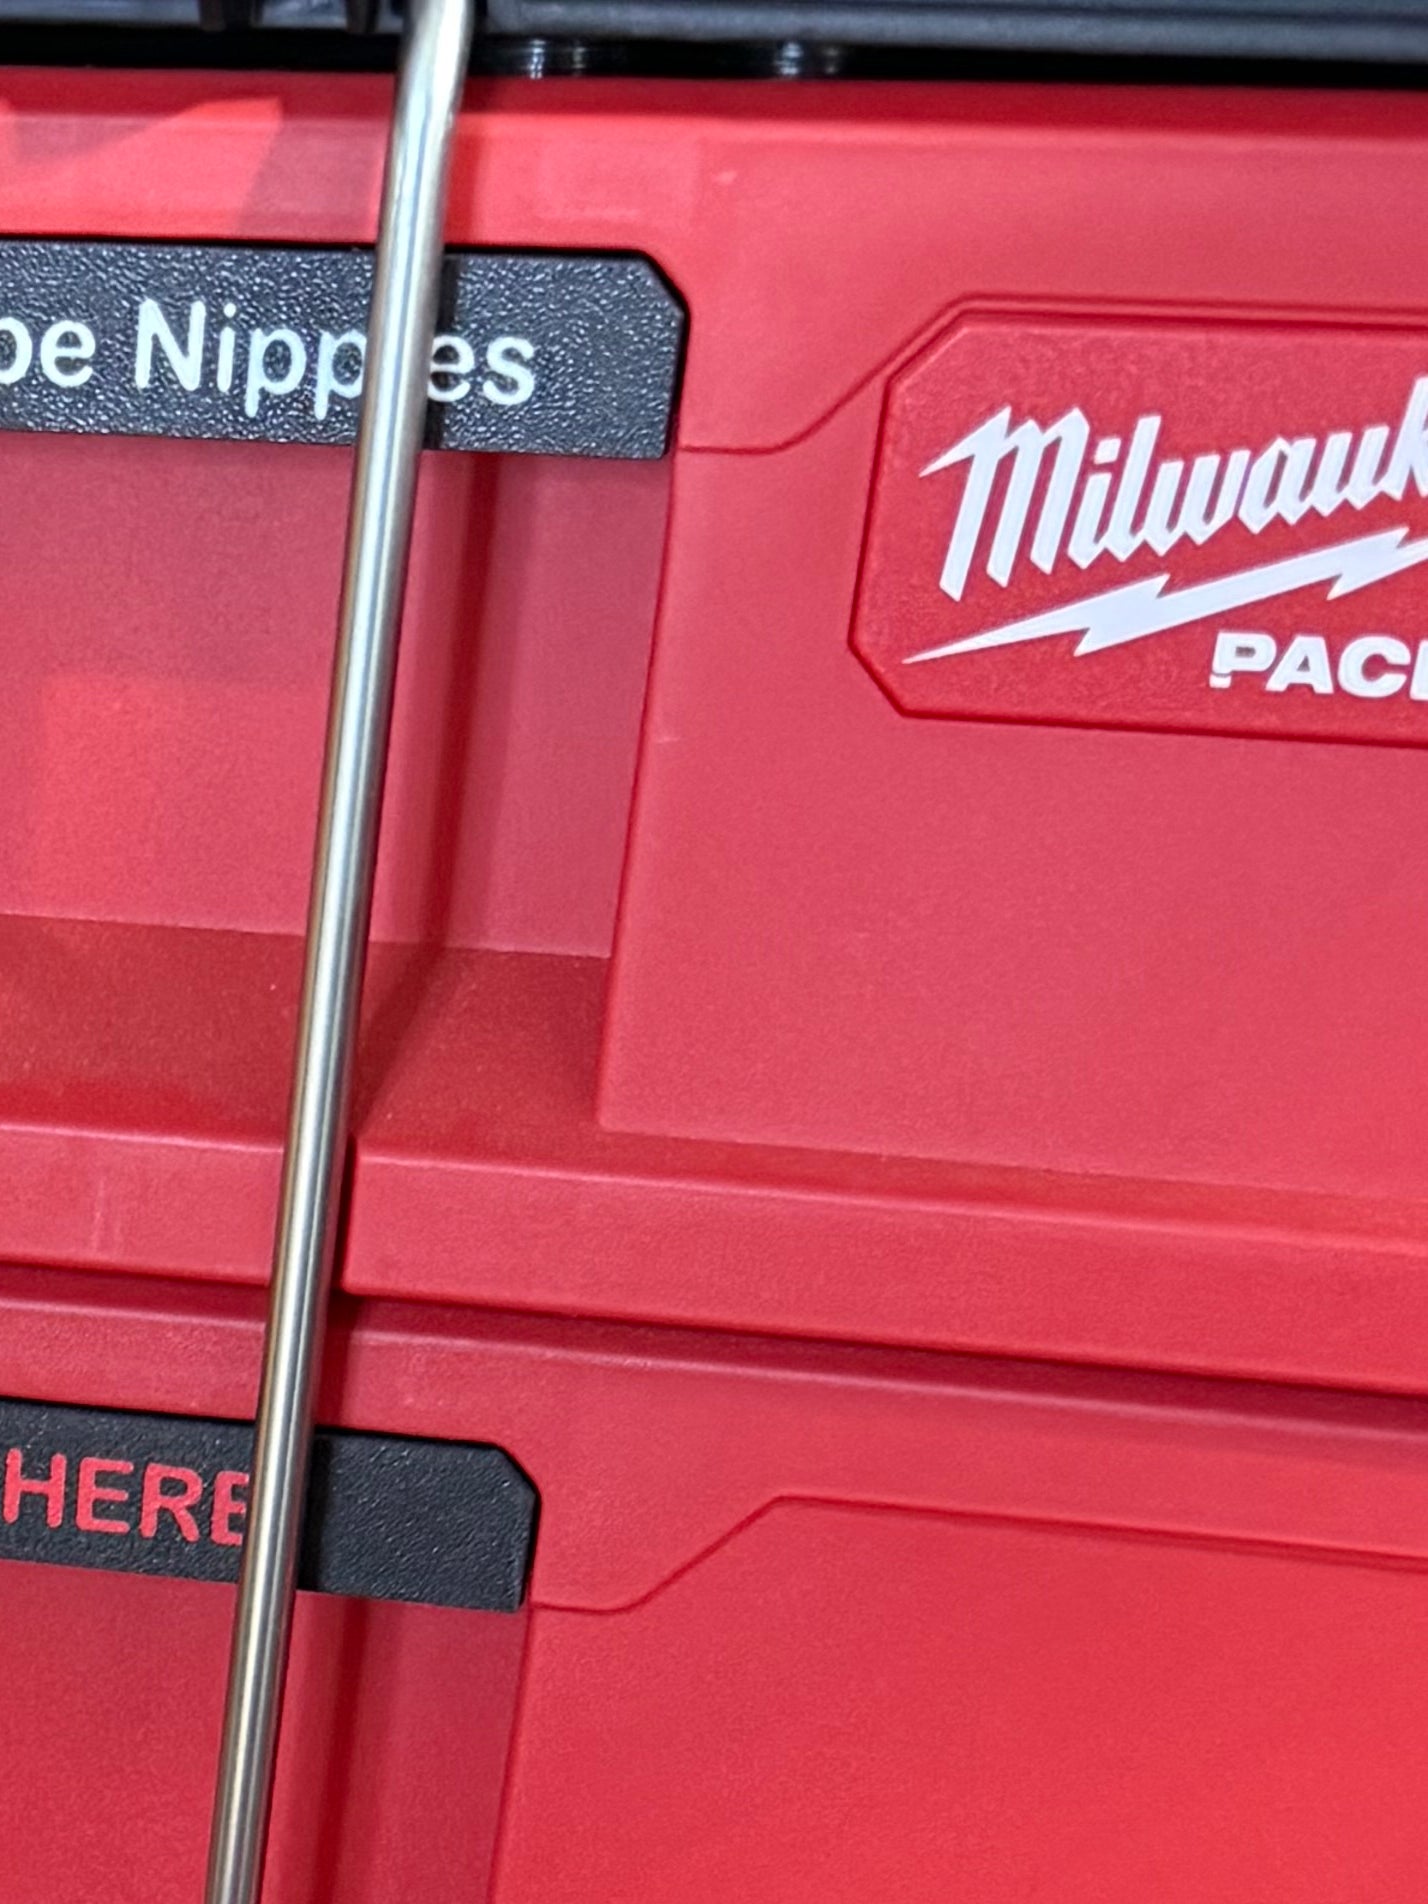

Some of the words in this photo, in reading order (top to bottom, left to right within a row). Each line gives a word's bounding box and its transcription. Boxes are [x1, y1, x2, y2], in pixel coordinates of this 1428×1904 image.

[131, 296, 541, 422] Nippes
[1208, 630, 1428, 701] PAC
[2, 1448, 249, 1546] HERE
